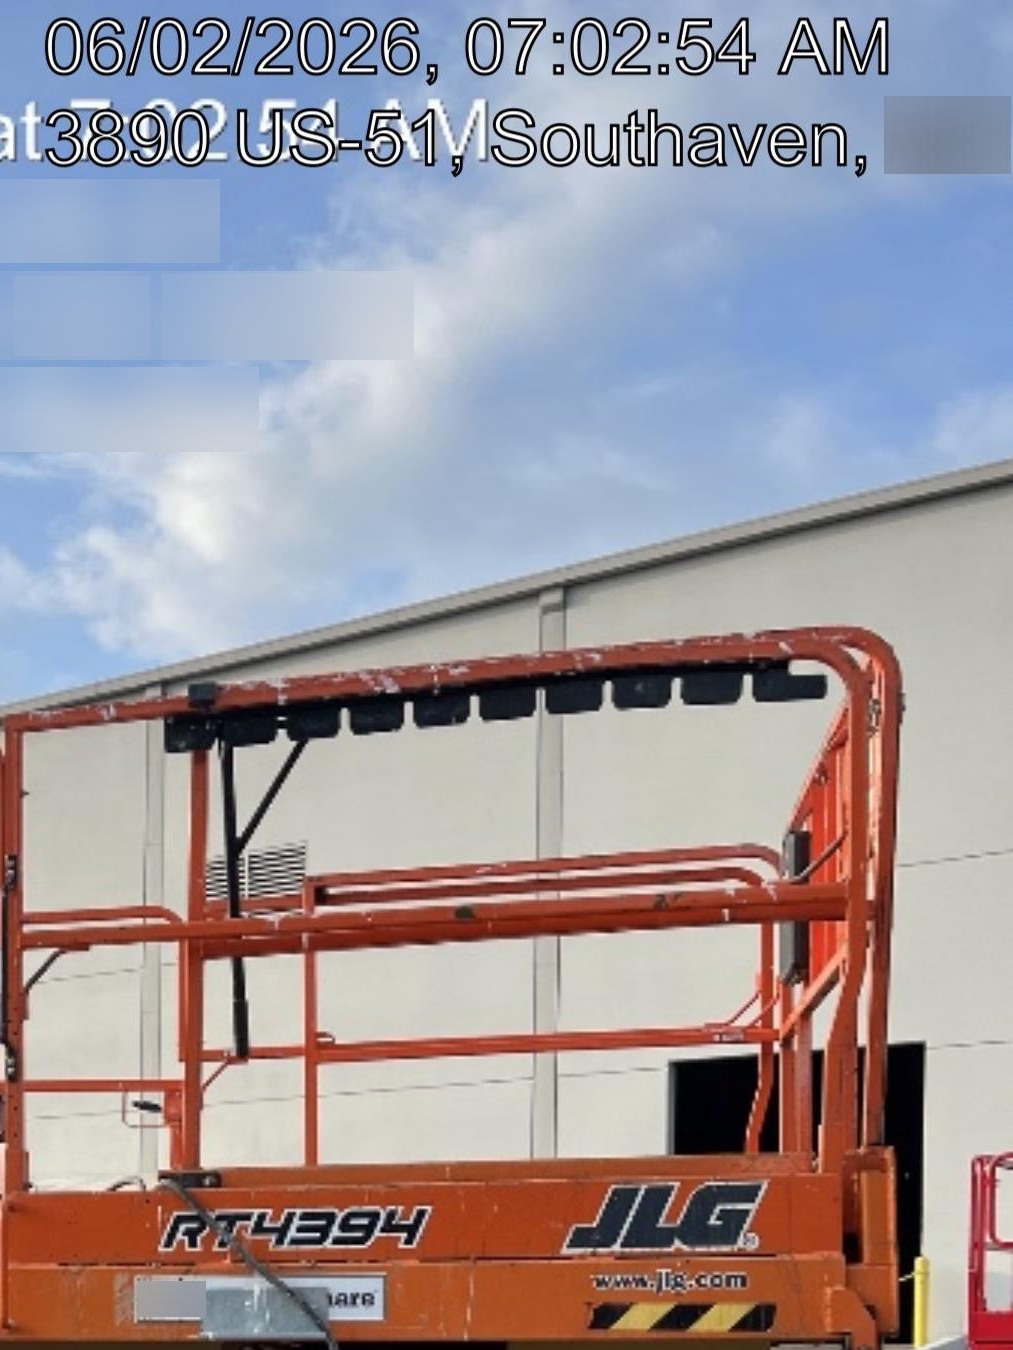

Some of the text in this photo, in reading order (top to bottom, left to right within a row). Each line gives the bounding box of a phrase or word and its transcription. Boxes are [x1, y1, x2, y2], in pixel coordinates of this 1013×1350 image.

[158, 1206, 433, 1251] RT4394
[561, 1181, 771, 1255] JLG
[592, 1270, 749, 1296] www.jlg.com
